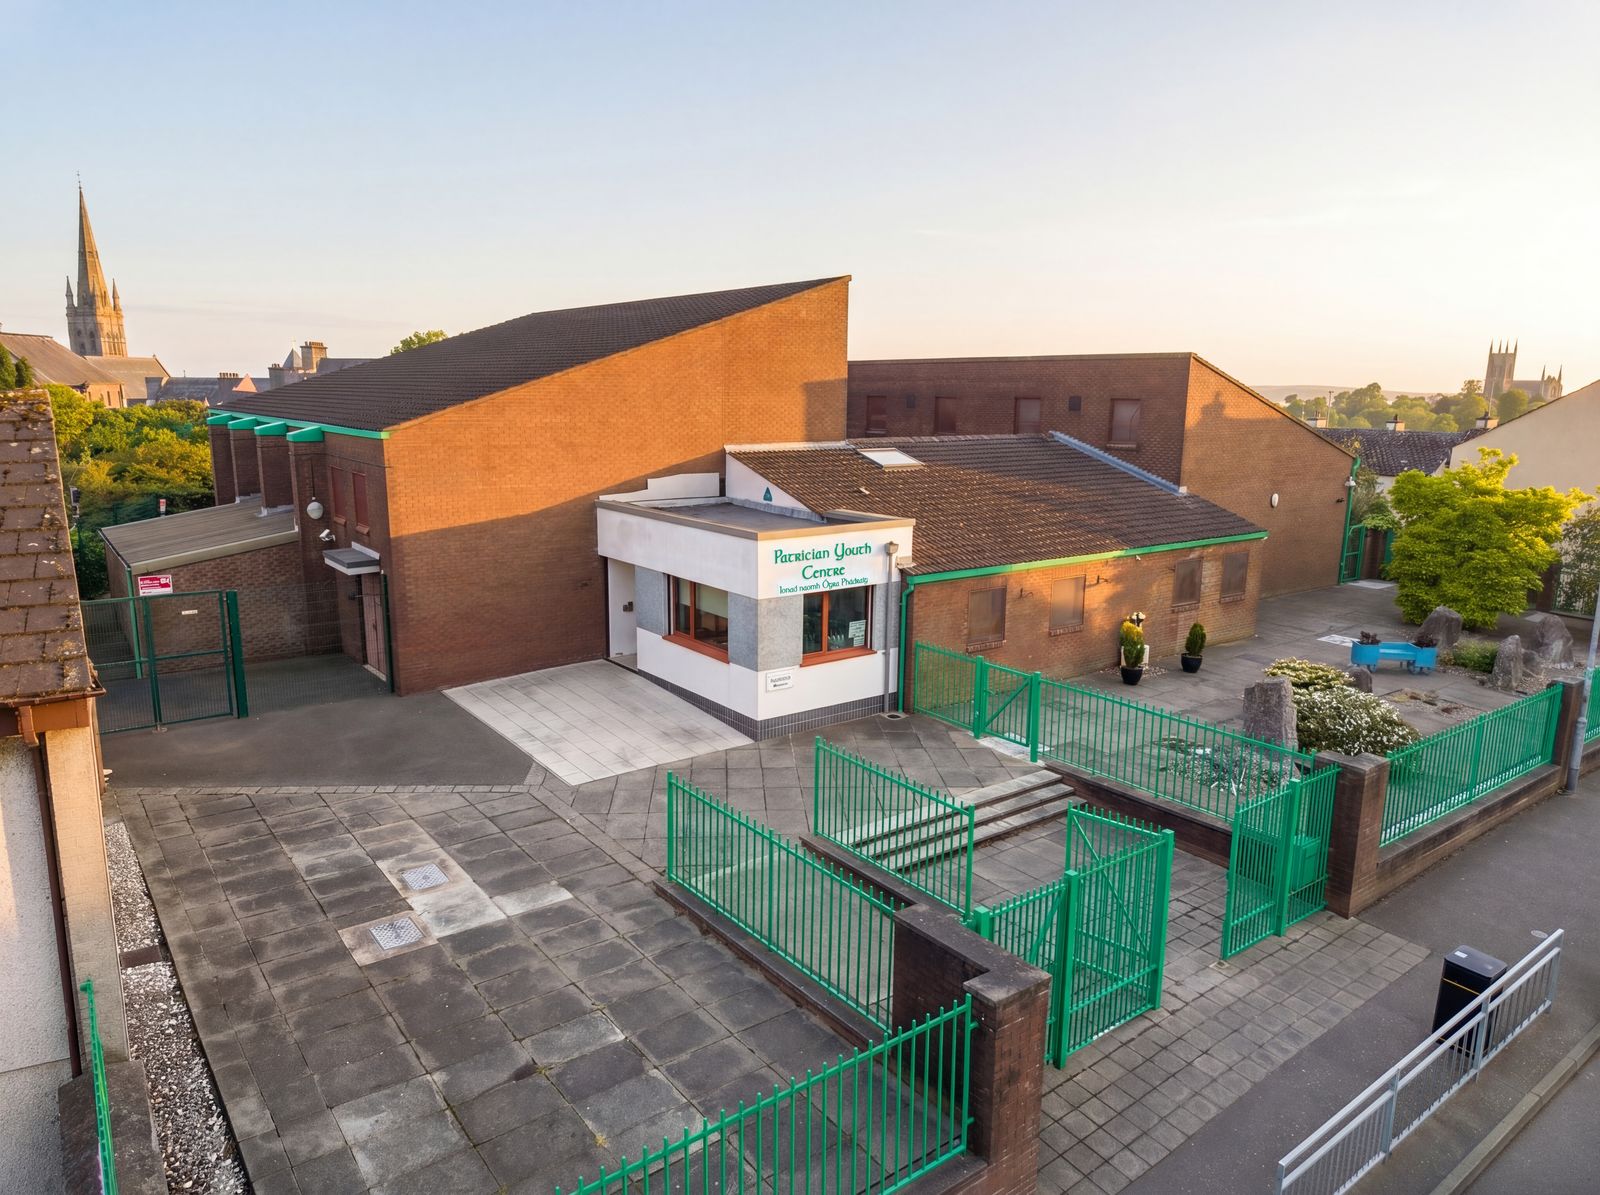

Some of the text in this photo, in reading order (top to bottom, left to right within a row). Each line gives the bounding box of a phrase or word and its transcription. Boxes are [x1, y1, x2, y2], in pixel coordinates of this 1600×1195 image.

[774, 542, 872, 564] Patrician Youth
[802, 565, 845, 579] Centre
